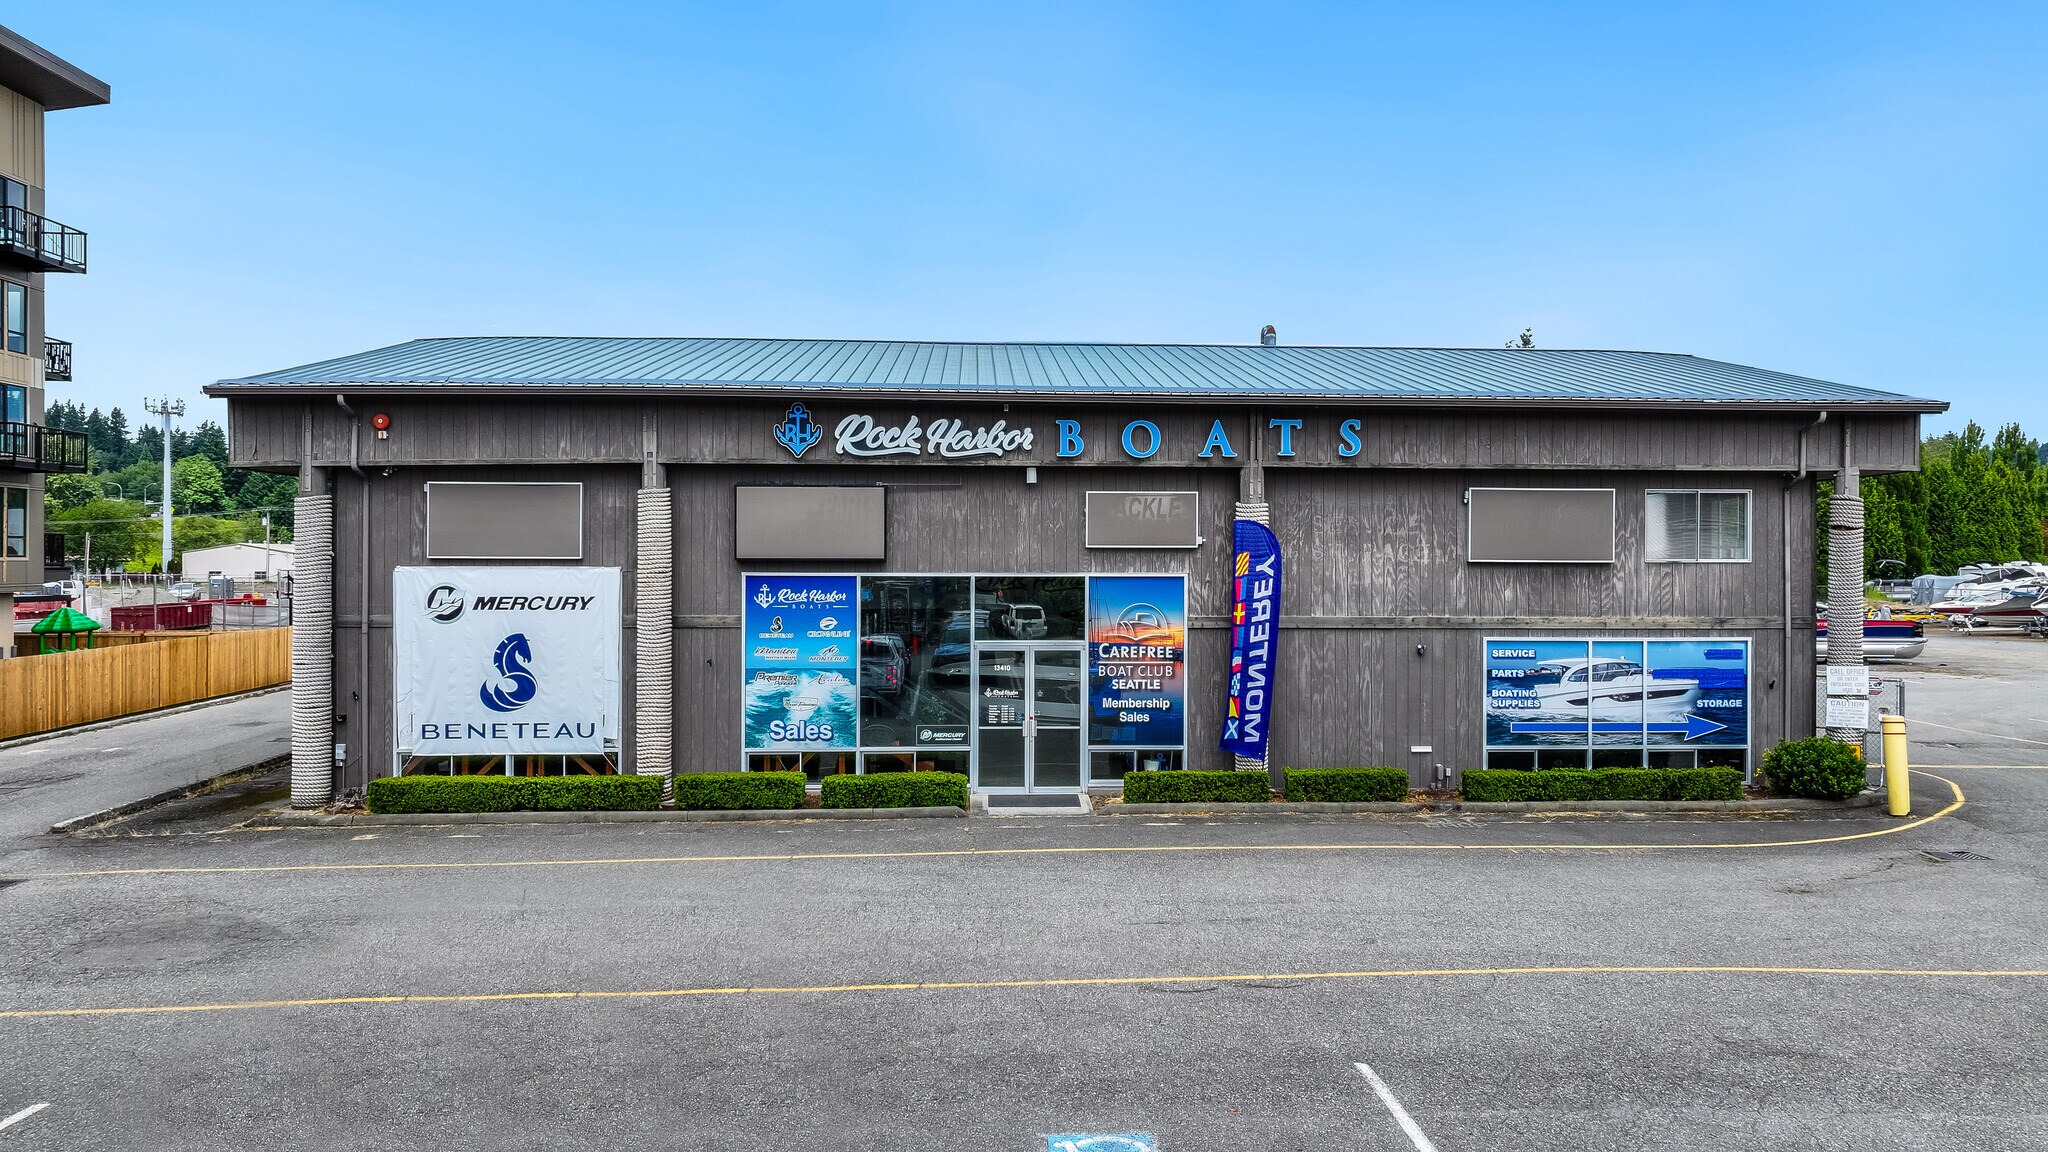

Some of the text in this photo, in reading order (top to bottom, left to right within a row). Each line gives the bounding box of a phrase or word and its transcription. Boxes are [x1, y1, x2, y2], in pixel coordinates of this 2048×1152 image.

[833, 414, 1363, 459] Rock Harbor BOATS
[777, 588, 847, 604] Rock Harbor
[471, 595, 597, 611] MERCURY
[1098, 643, 1175, 659] CAREFREE
[1491, 649, 1536, 658] SERVICE
[1098, 665, 1173, 677] BOAT CLUB
[1491, 669, 1525, 678] PARTS
[755, 672, 798, 683] Premier
[1111, 679, 1161, 690] SEATTLE
[1491, 689, 1537, 698] BOATING
[1102, 697, 1171, 711] Membership
[1491, 699, 1541, 708] SUPPLIES
[1696, 699, 1743, 709] STORAGE
[1119, 711, 1150, 723] Sales
[421, 722, 596, 740] BENETEAU
[770, 720, 833, 741] Sales
